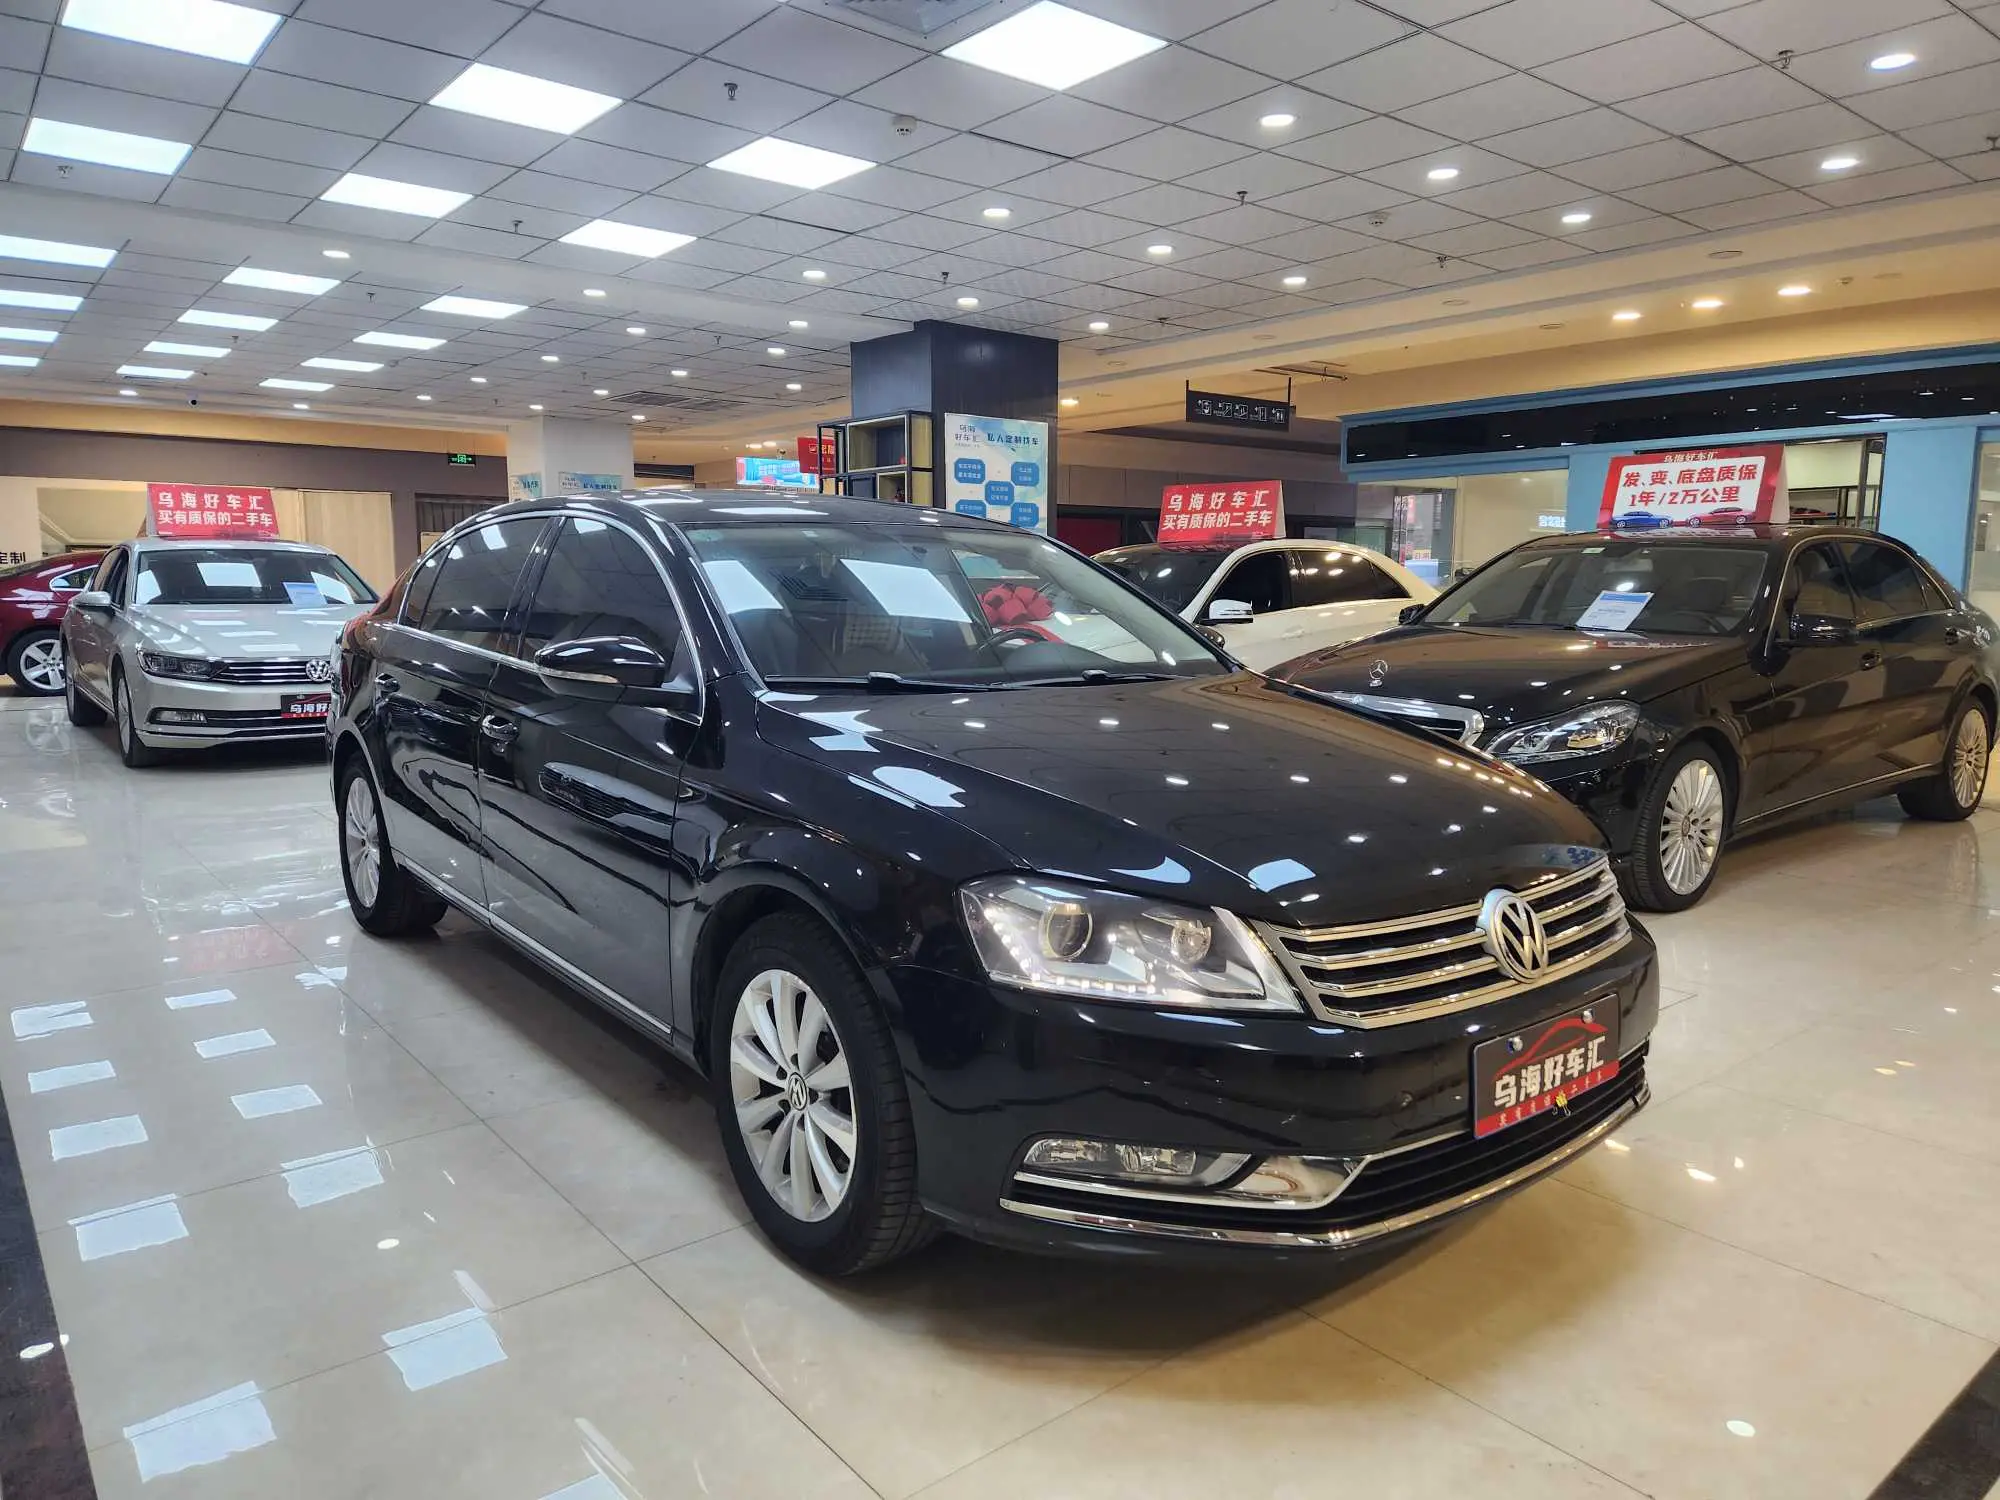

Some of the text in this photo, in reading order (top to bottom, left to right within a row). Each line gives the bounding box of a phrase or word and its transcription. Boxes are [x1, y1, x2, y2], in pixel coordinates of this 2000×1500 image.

[1623, 464, 1758, 488] 发、变、底盘质保
[158, 492, 264, 510] 乌海好车汇
[1168, 490, 1269, 511] 乌海好车汇
[1628, 486, 1740, 507] 1年/2万公里
[158, 510, 273, 527] 买有质保的二手车
[1162, 510, 1272, 530] 买有质保的二手车
[1494, 1036, 1606, 1108] 乌海好车汇
